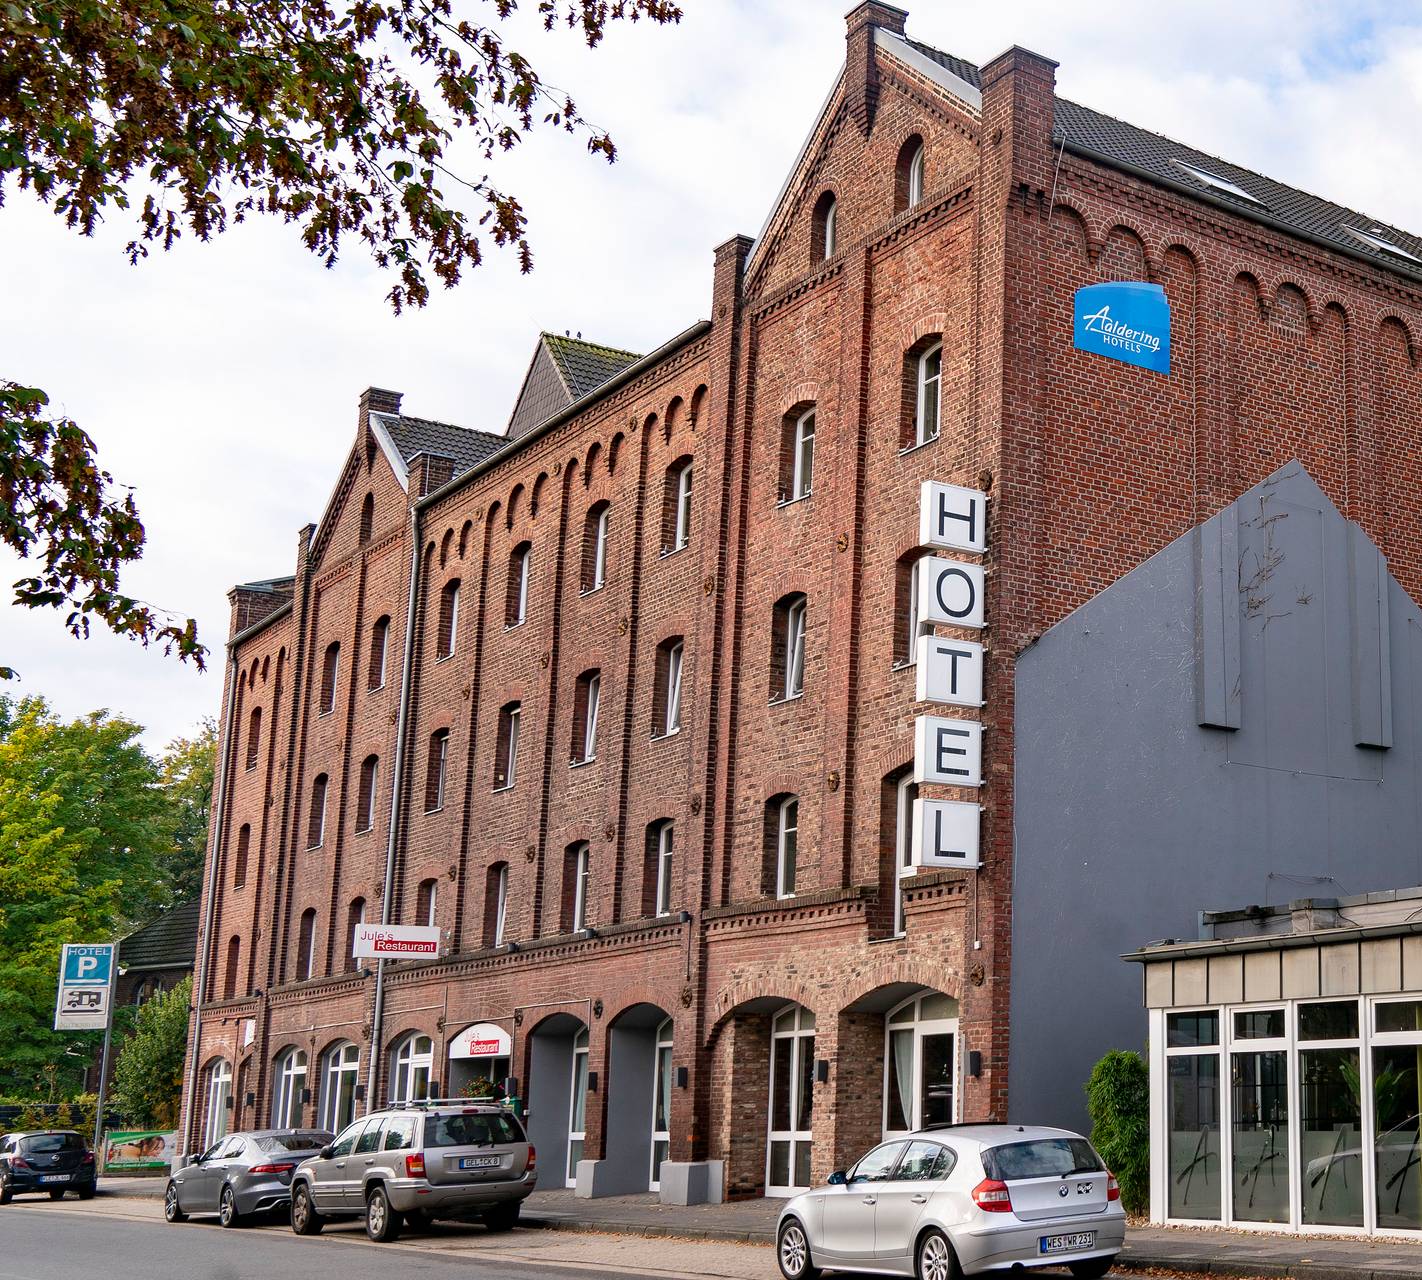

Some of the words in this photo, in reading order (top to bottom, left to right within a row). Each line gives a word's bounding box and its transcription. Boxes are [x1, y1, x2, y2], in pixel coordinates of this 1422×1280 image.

[1083, 305, 1160, 352] Aaldering
[1103, 335, 1141, 353] HOTELS
[934, 492, 975, 858] HOTEL
[361, 931, 394, 941] Jule's
[68, 948, 110, 956] HOTEL
[377, 940, 434, 952] Restaurant
[78, 956, 98, 978] P
